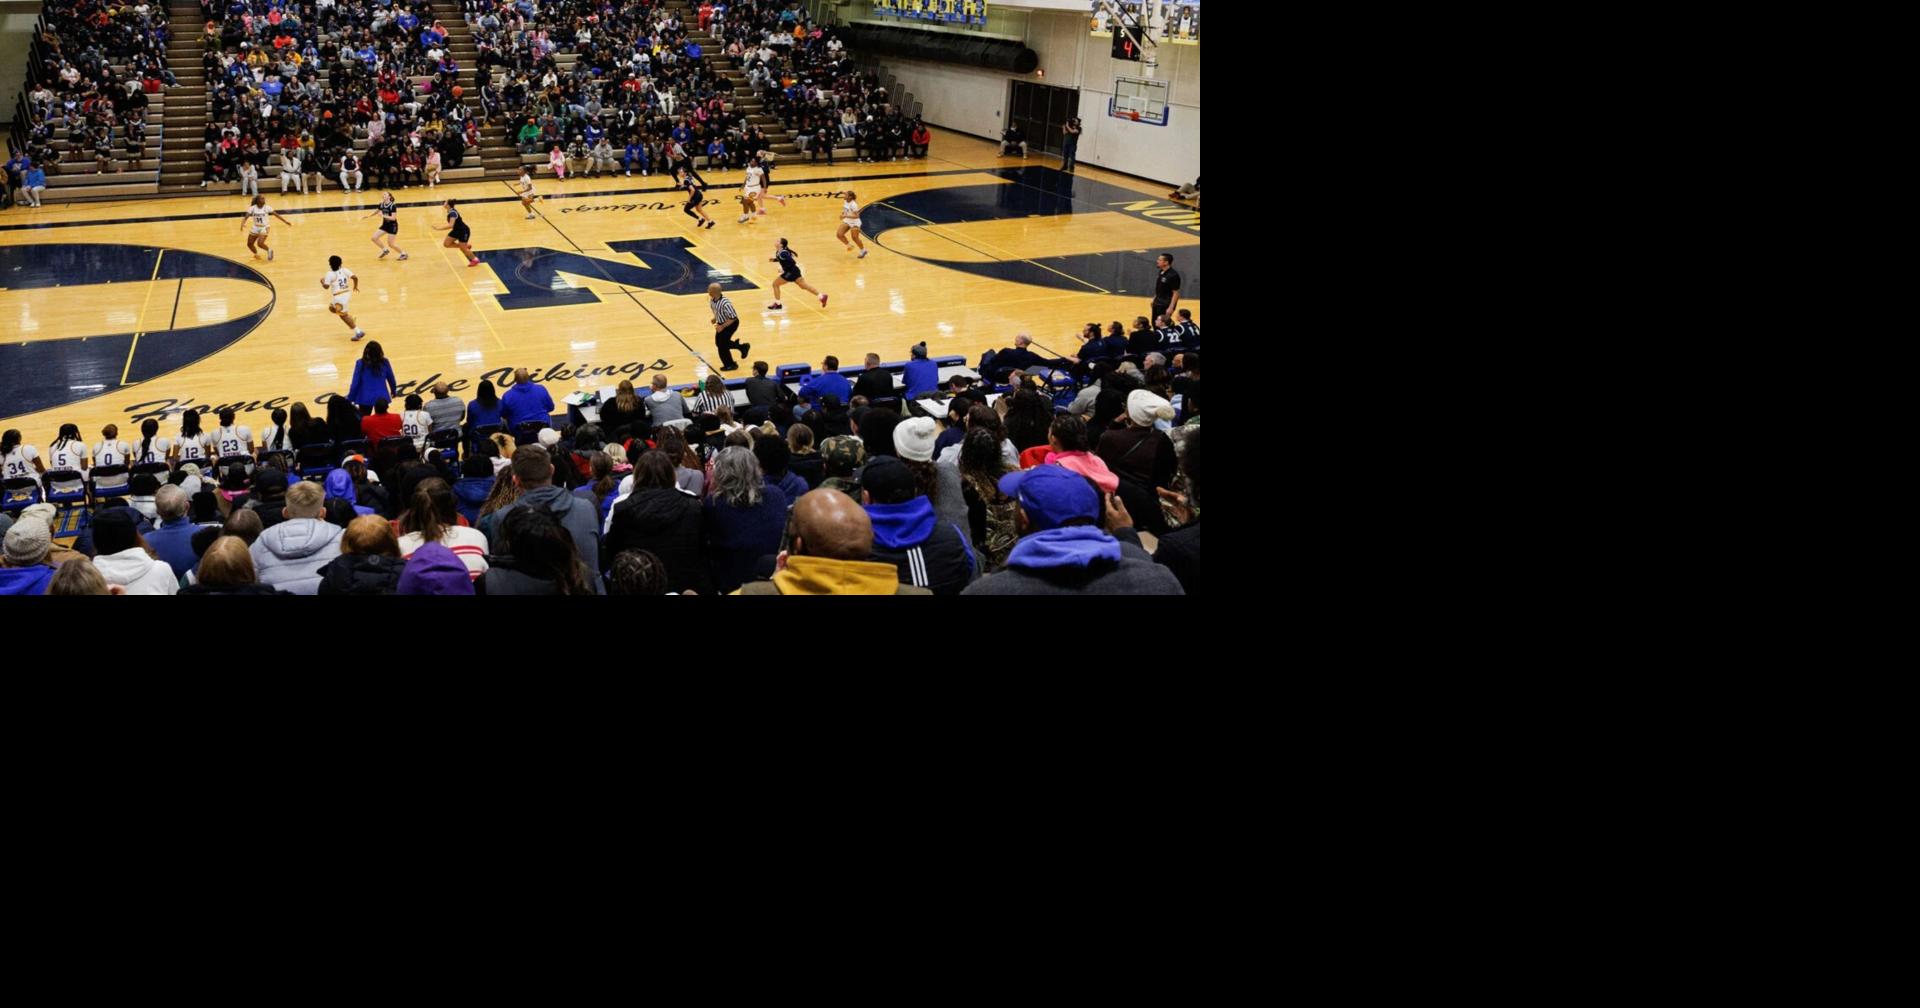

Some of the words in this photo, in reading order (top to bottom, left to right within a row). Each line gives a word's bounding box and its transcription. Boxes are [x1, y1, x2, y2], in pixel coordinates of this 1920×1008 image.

[1124, 41, 1133, 58] 4
[561, 201, 675, 213] Vikings
[473, 236, 761, 311] N
[1167, 332, 1181, 343] 22
[481, 358, 673, 388] Vikings
[403, 424, 418, 436] 20
[222, 439, 239, 452] 23
[58, 453, 66, 466] 5
[104, 453, 112, 466] 0
[185, 447, 198, 459] 12
[7, 460, 26, 475] 34
